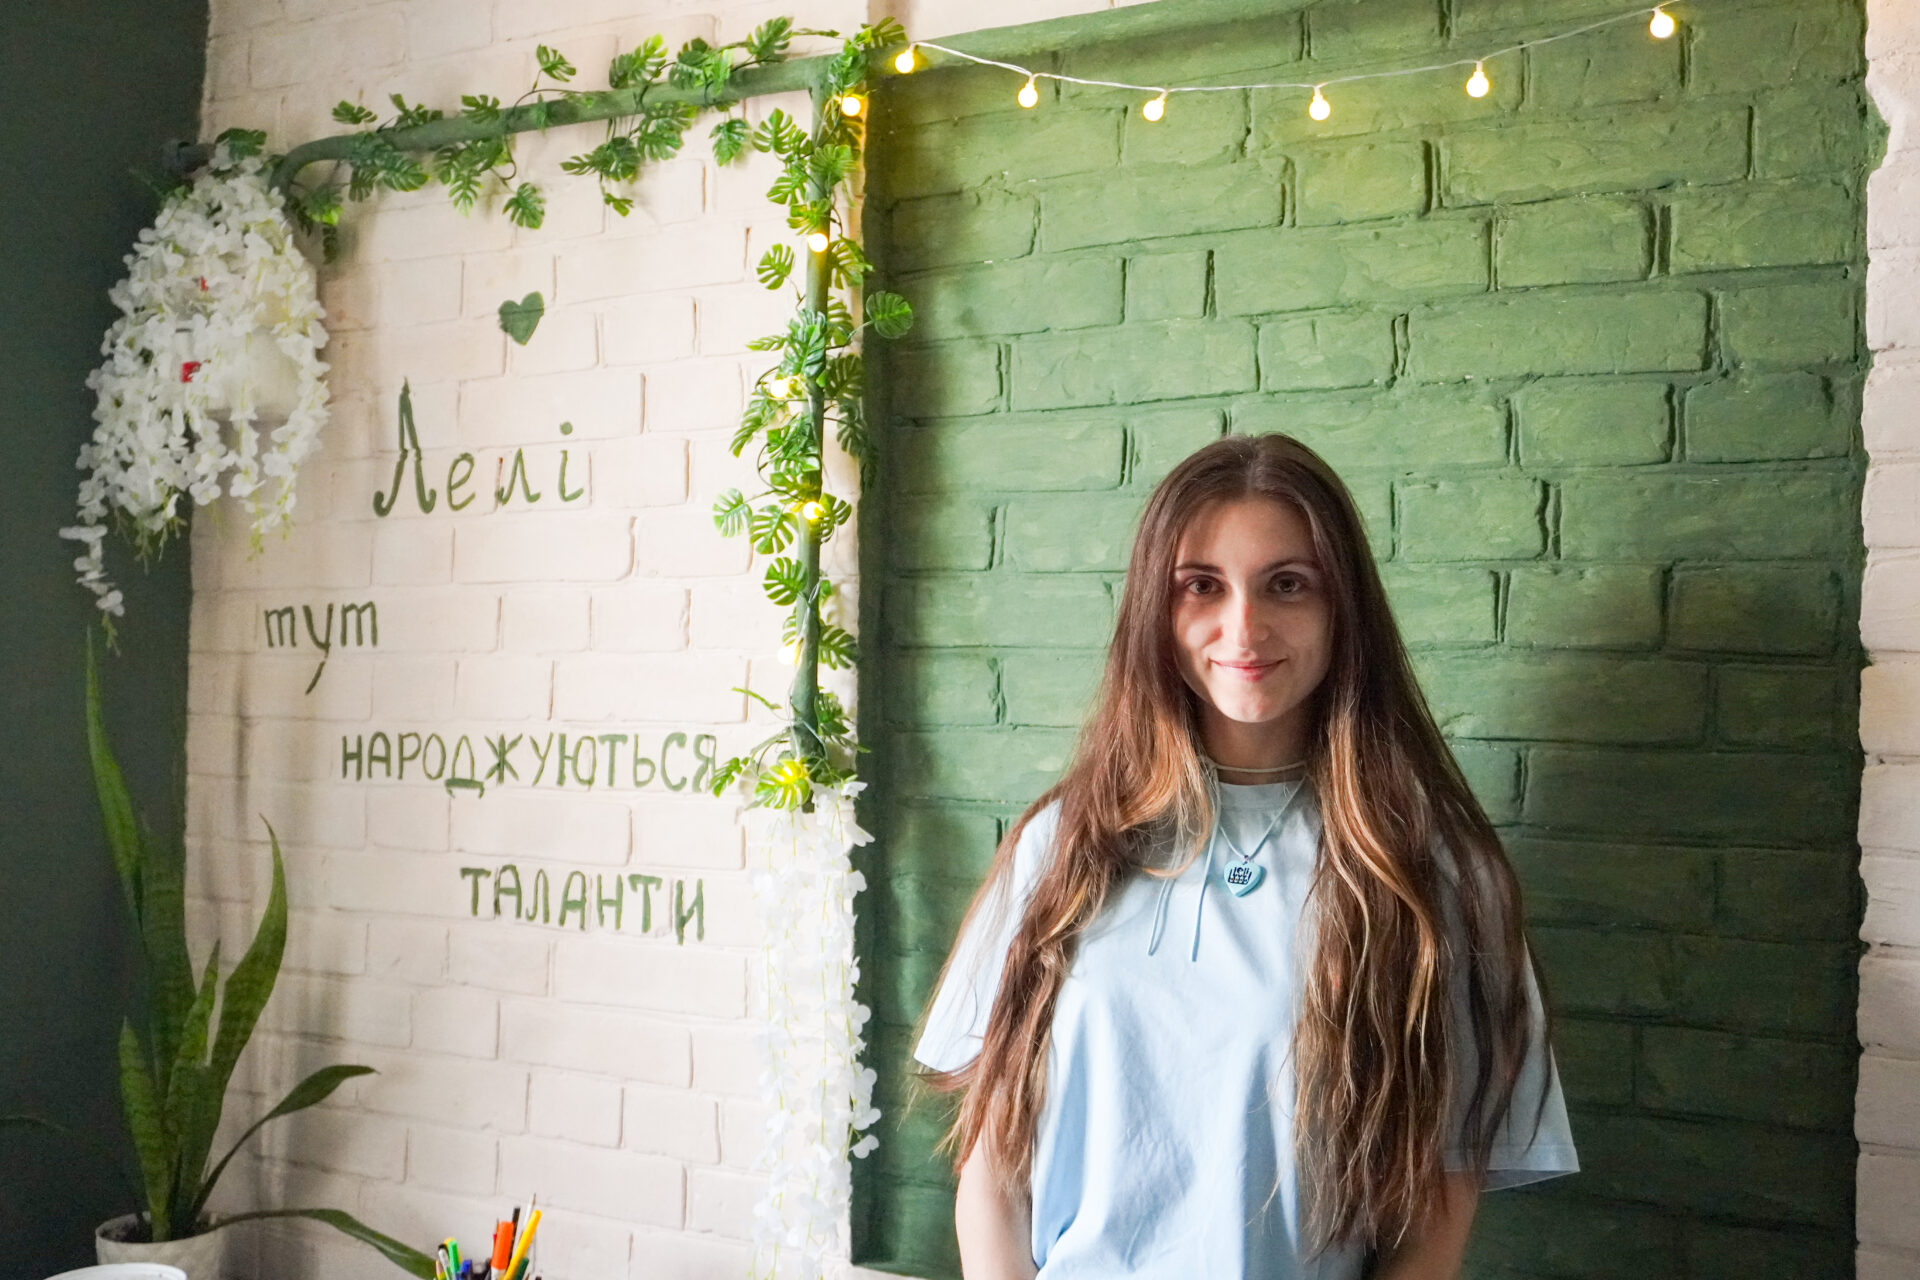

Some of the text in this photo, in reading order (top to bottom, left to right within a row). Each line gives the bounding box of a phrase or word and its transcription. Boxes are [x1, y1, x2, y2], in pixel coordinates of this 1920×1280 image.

[373, 377, 584, 517] Лелі
[264, 600, 379, 695] тут
[341, 731, 717, 798] НАРОДЖУЮТЬСЯ
[460, 864, 704, 945] ТАЛАНТИ
